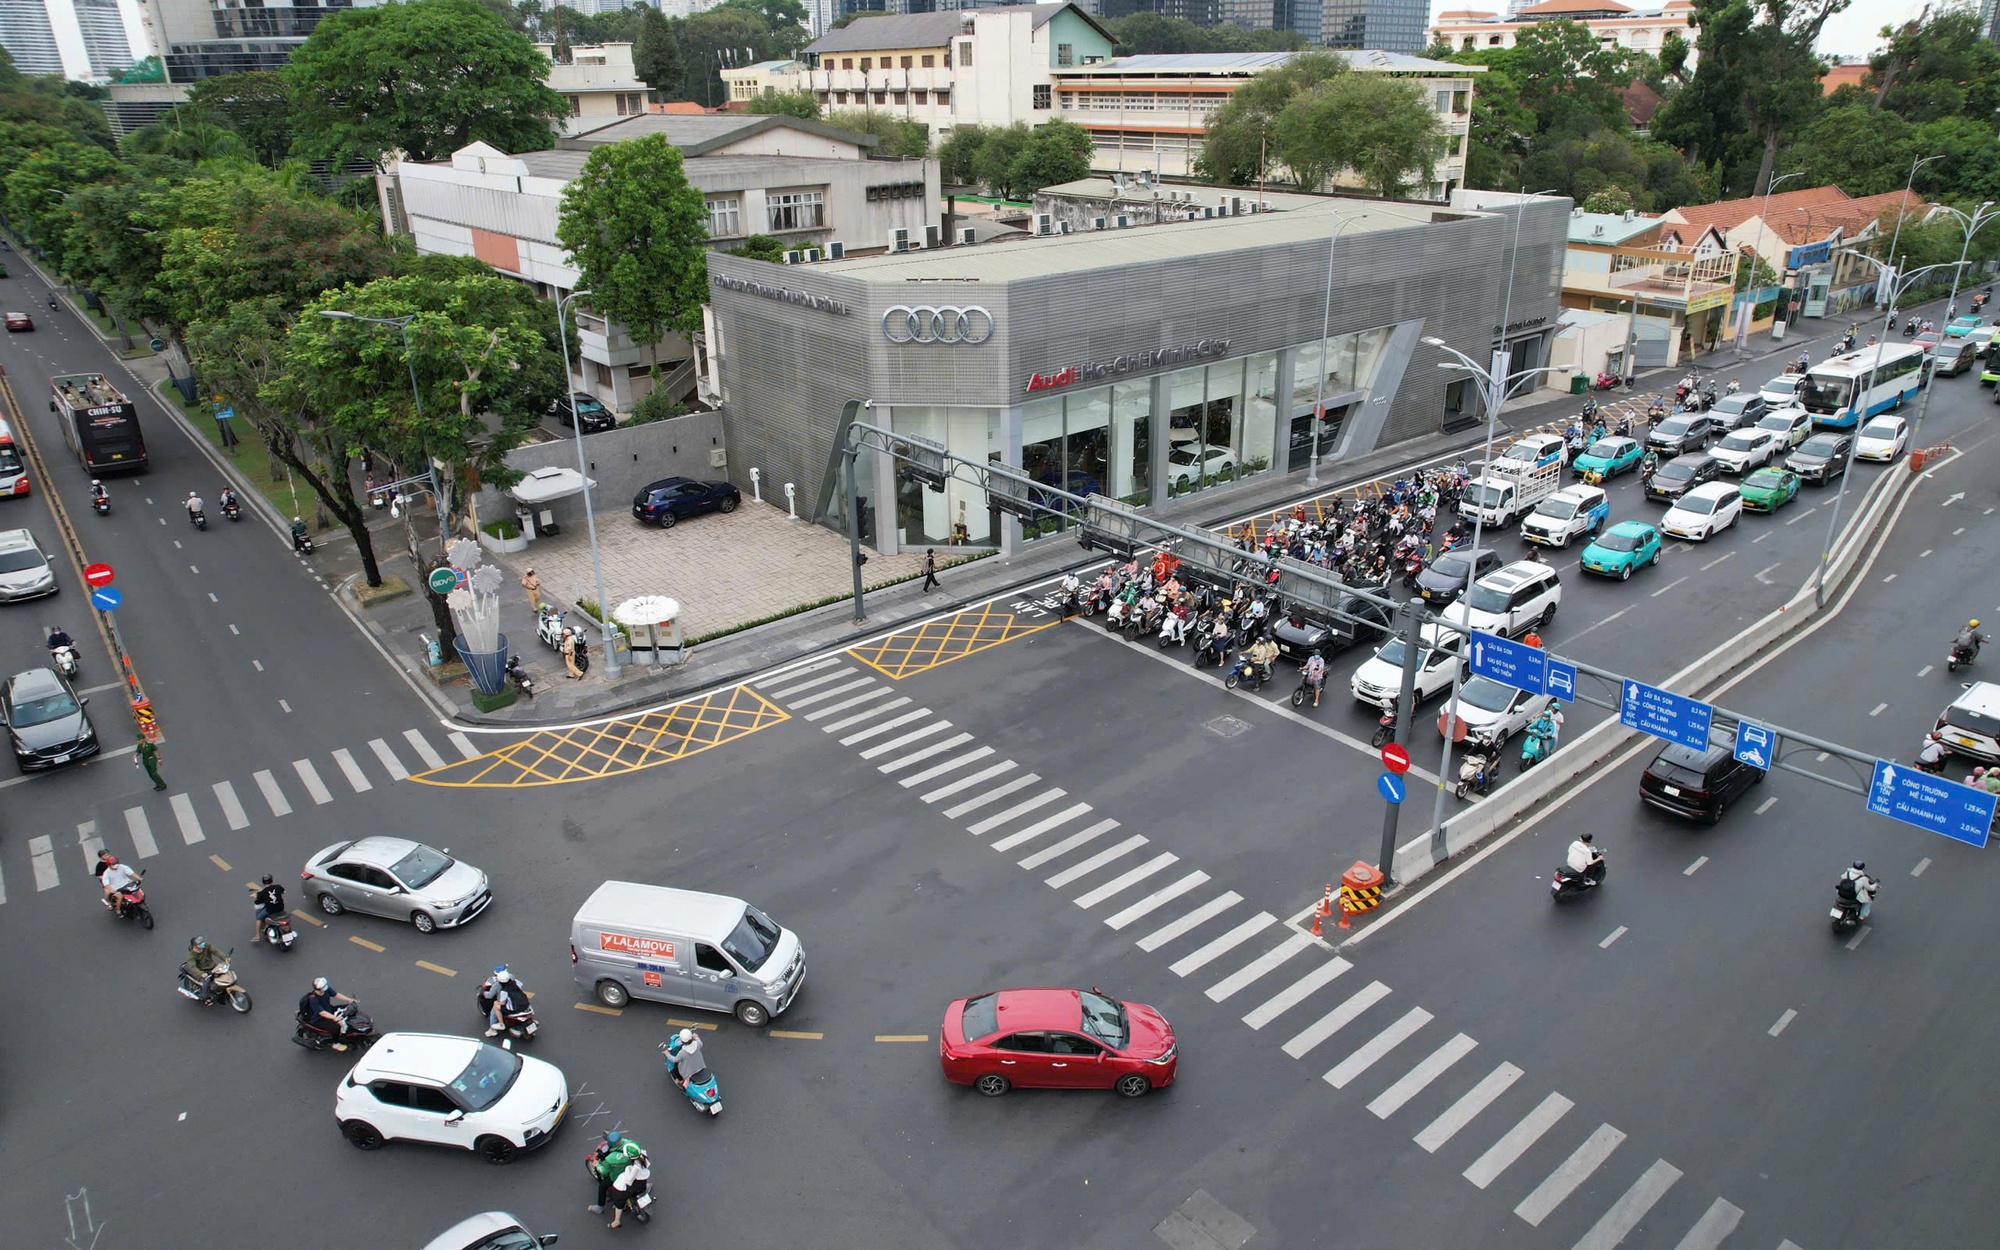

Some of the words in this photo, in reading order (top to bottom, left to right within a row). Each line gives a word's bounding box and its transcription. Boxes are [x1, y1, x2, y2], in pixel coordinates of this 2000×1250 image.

[1026, 366, 1077, 392] Audi
[1080, 361, 1108, 382] Ho
[1113, 353, 1144, 375] Chi
[1149, 345, 1193, 368] Minh
[1197, 338, 1232, 357] City
[88, 406, 122, 416] CHIN-SU
[432, 578, 449, 588] BIDV
[1643, 701, 1656, 711] CÔNG
[1657, 706, 1677, 718] TRƯỜNG
[1657, 715, 1668, 723] LINH
[1641, 719, 1650, 728] CẦU
[1651, 723, 1668, 733] KHÁNH
[1669, 729, 1678, 737] HỘI
[1880, 788, 1890, 796] TÔN
[1902, 779, 1920, 790] CÔNG
[1921, 784, 1949, 798] TRƯỜNG
[1909, 791, 1919, 799] MÊ
[1920, 793, 1936, 804] LINH
[1896, 802, 1909, 812] CẦU
[1910, 806, 1933, 820] KHÁNH
[1934, 814, 1947, 823] HỘI
[1964, 803, 1975, 811] 1.25
[1976, 806, 1986, 816] Km
[1960, 823, 1970, 832] 2.0
[1970, 825, 1981, 835] Km
[613, 936, 673, 952] LALAMOVE
